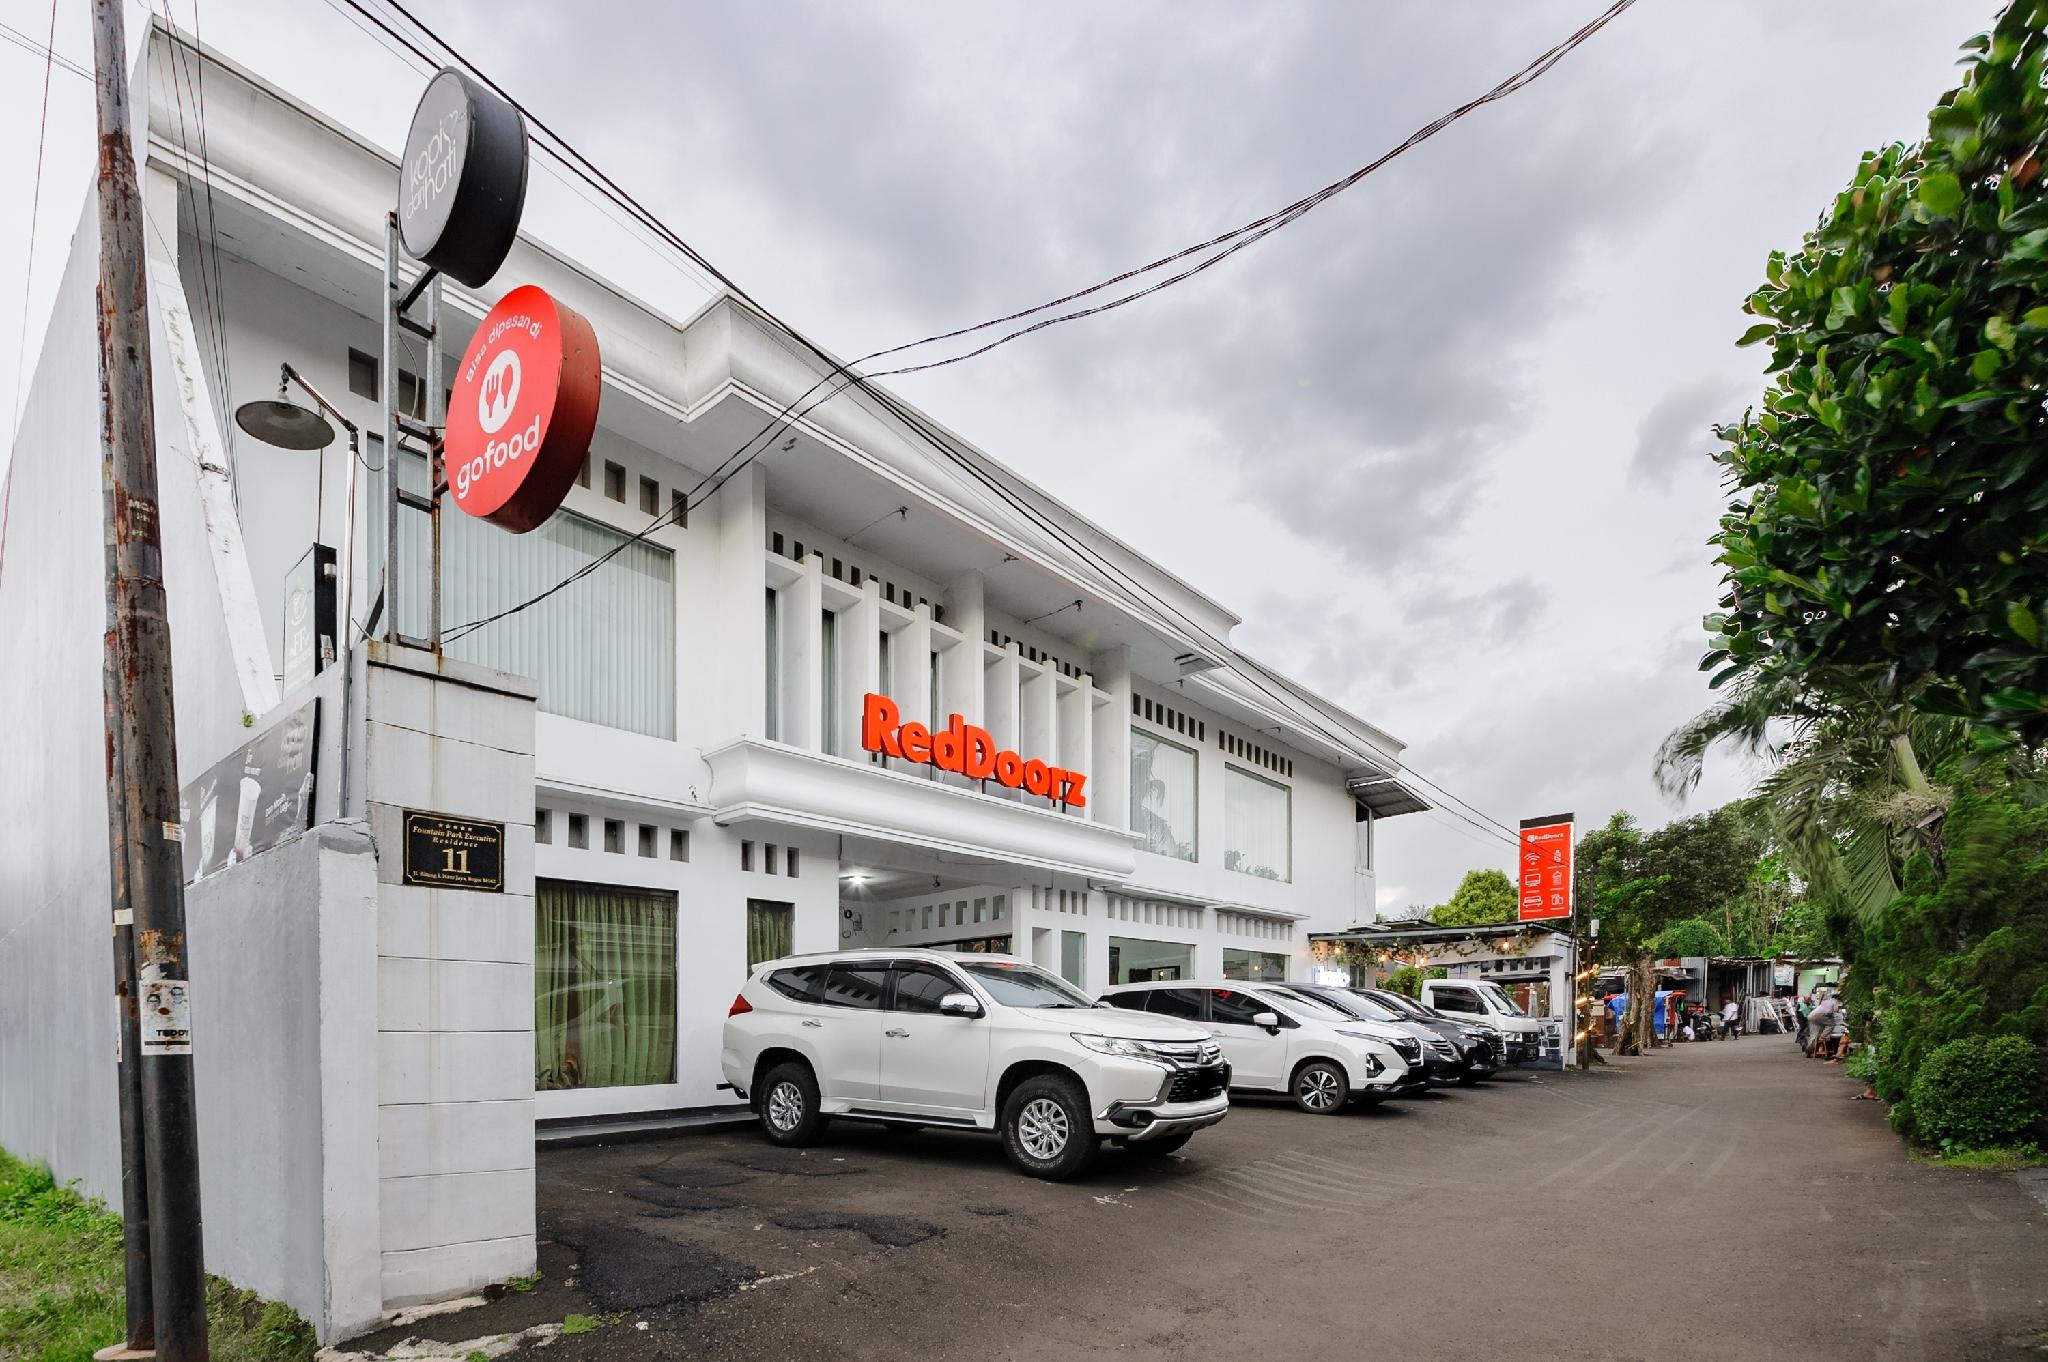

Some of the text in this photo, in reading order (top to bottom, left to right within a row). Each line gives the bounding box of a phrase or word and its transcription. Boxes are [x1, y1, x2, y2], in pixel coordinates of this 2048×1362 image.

[464, 312, 543, 384] Bisa dipesan di
[457, 414, 541, 500] gofood
[862, 692, 1087, 808] RedDoorz
[412, 825, 496, 842] Fountain Park Executive
[432, 837, 478, 848] Residence
[442, 848, 471, 874] 11
